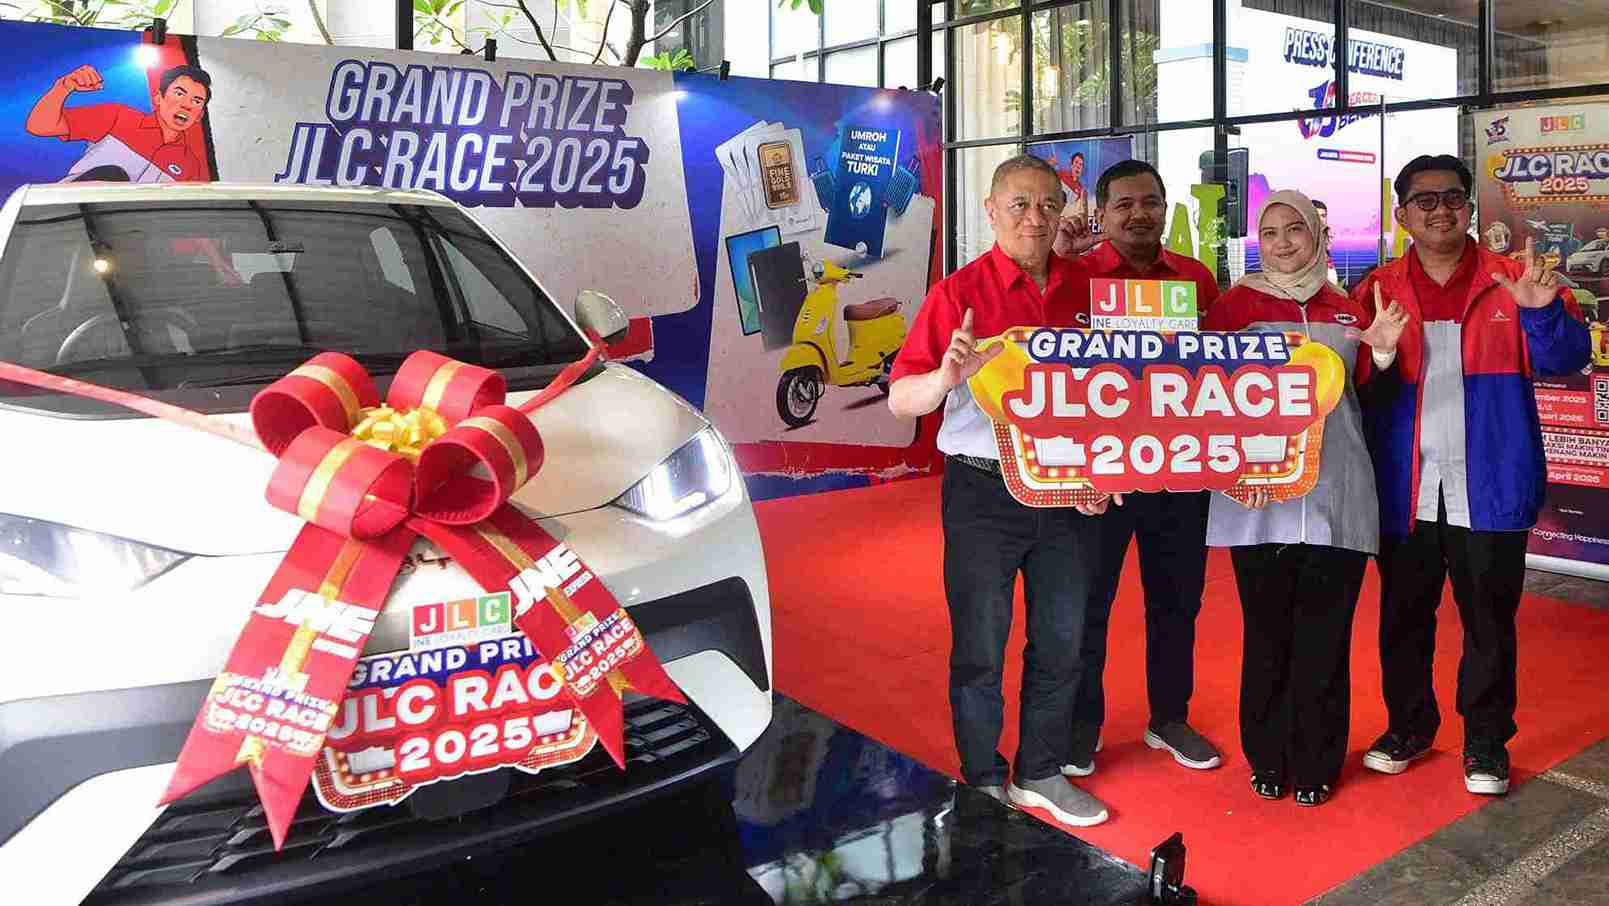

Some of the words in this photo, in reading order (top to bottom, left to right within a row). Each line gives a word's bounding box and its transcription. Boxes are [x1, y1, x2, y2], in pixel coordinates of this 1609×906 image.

[1284, 26, 1328, 67] PRESS
[328, 61, 492, 127] GRAND
[500, 73, 626, 134] PRIZE
[850, 130, 887, 143] UMROH
[858, 143, 876, 151] ATAU
[274, 124, 374, 188] JLC
[382, 130, 514, 193] RACE
[516, 136, 640, 196] 2025
[841, 151, 864, 161] PAKET
[864, 154, 891, 166] WISATA
[847, 160, 879, 176] TURKI
[1494, 153, 1550, 179] JLC
[1552, 151, 1609, 177] RAC
[1540, 177, 1589, 193] 2025
[1099, 283, 1188, 313] JLC
[1030, 331, 1168, 361] GRAND
[1178, 333, 1288, 361] PRIZE
[1008, 370, 1132, 419] JLC
[1150, 371, 1312, 419] RACE
[1091, 434, 1241, 475] 2025
[1548, 435, 1577, 444] LEBIH
[1578, 437, 1609, 447] BANYA
[1532, 528, 1573, 541] Connecting
[508, 542, 583, 621] JNE
[420, 599, 501, 633] JLC
[560, 635, 593, 664] GRAND
[592, 611, 620, 637] PRIZE
[564, 650, 594, 680] JLC
[592, 617, 635, 657] RACE
[351, 648, 467, 686] GRAND
[480, 637, 534, 665] PRI
[589, 645, 626, 680] 2025
[265, 700, 333, 733] RACE
[327, 684, 436, 741] JLC
[453, 662, 563, 717] RAC
[400, 717, 532, 773] 2025
